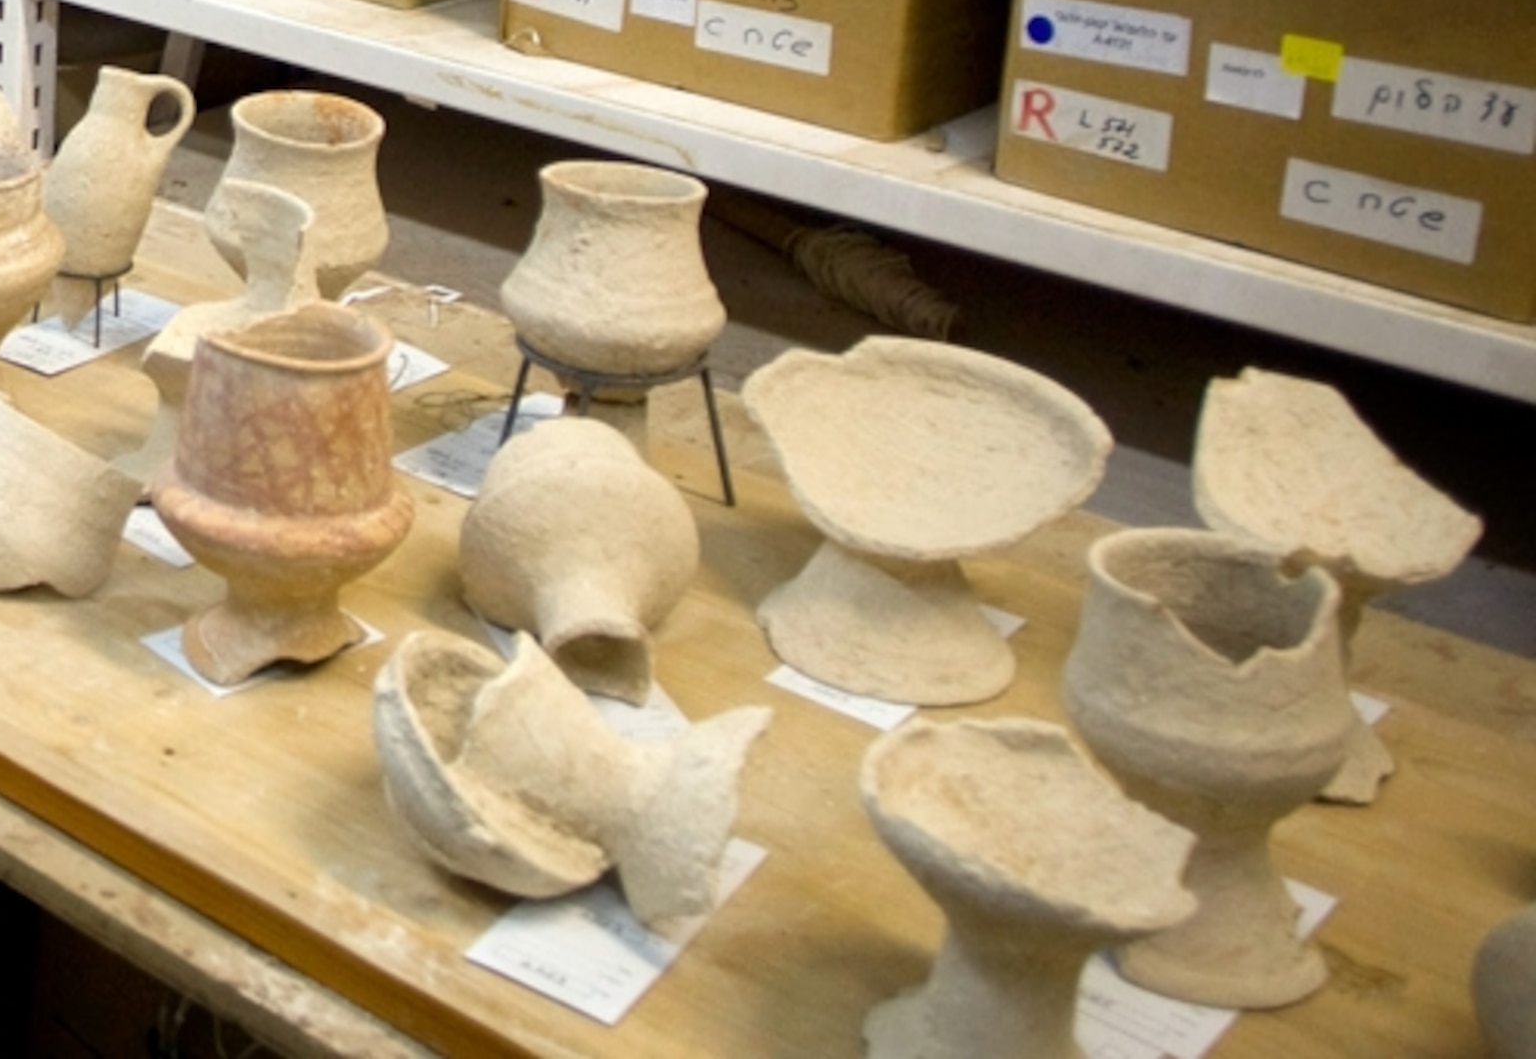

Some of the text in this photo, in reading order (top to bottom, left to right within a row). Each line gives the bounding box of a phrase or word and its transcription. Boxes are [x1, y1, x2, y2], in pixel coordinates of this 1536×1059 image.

[1017, 87, 1137, 141] R L 571
[1302, 178, 1333, 206] C
